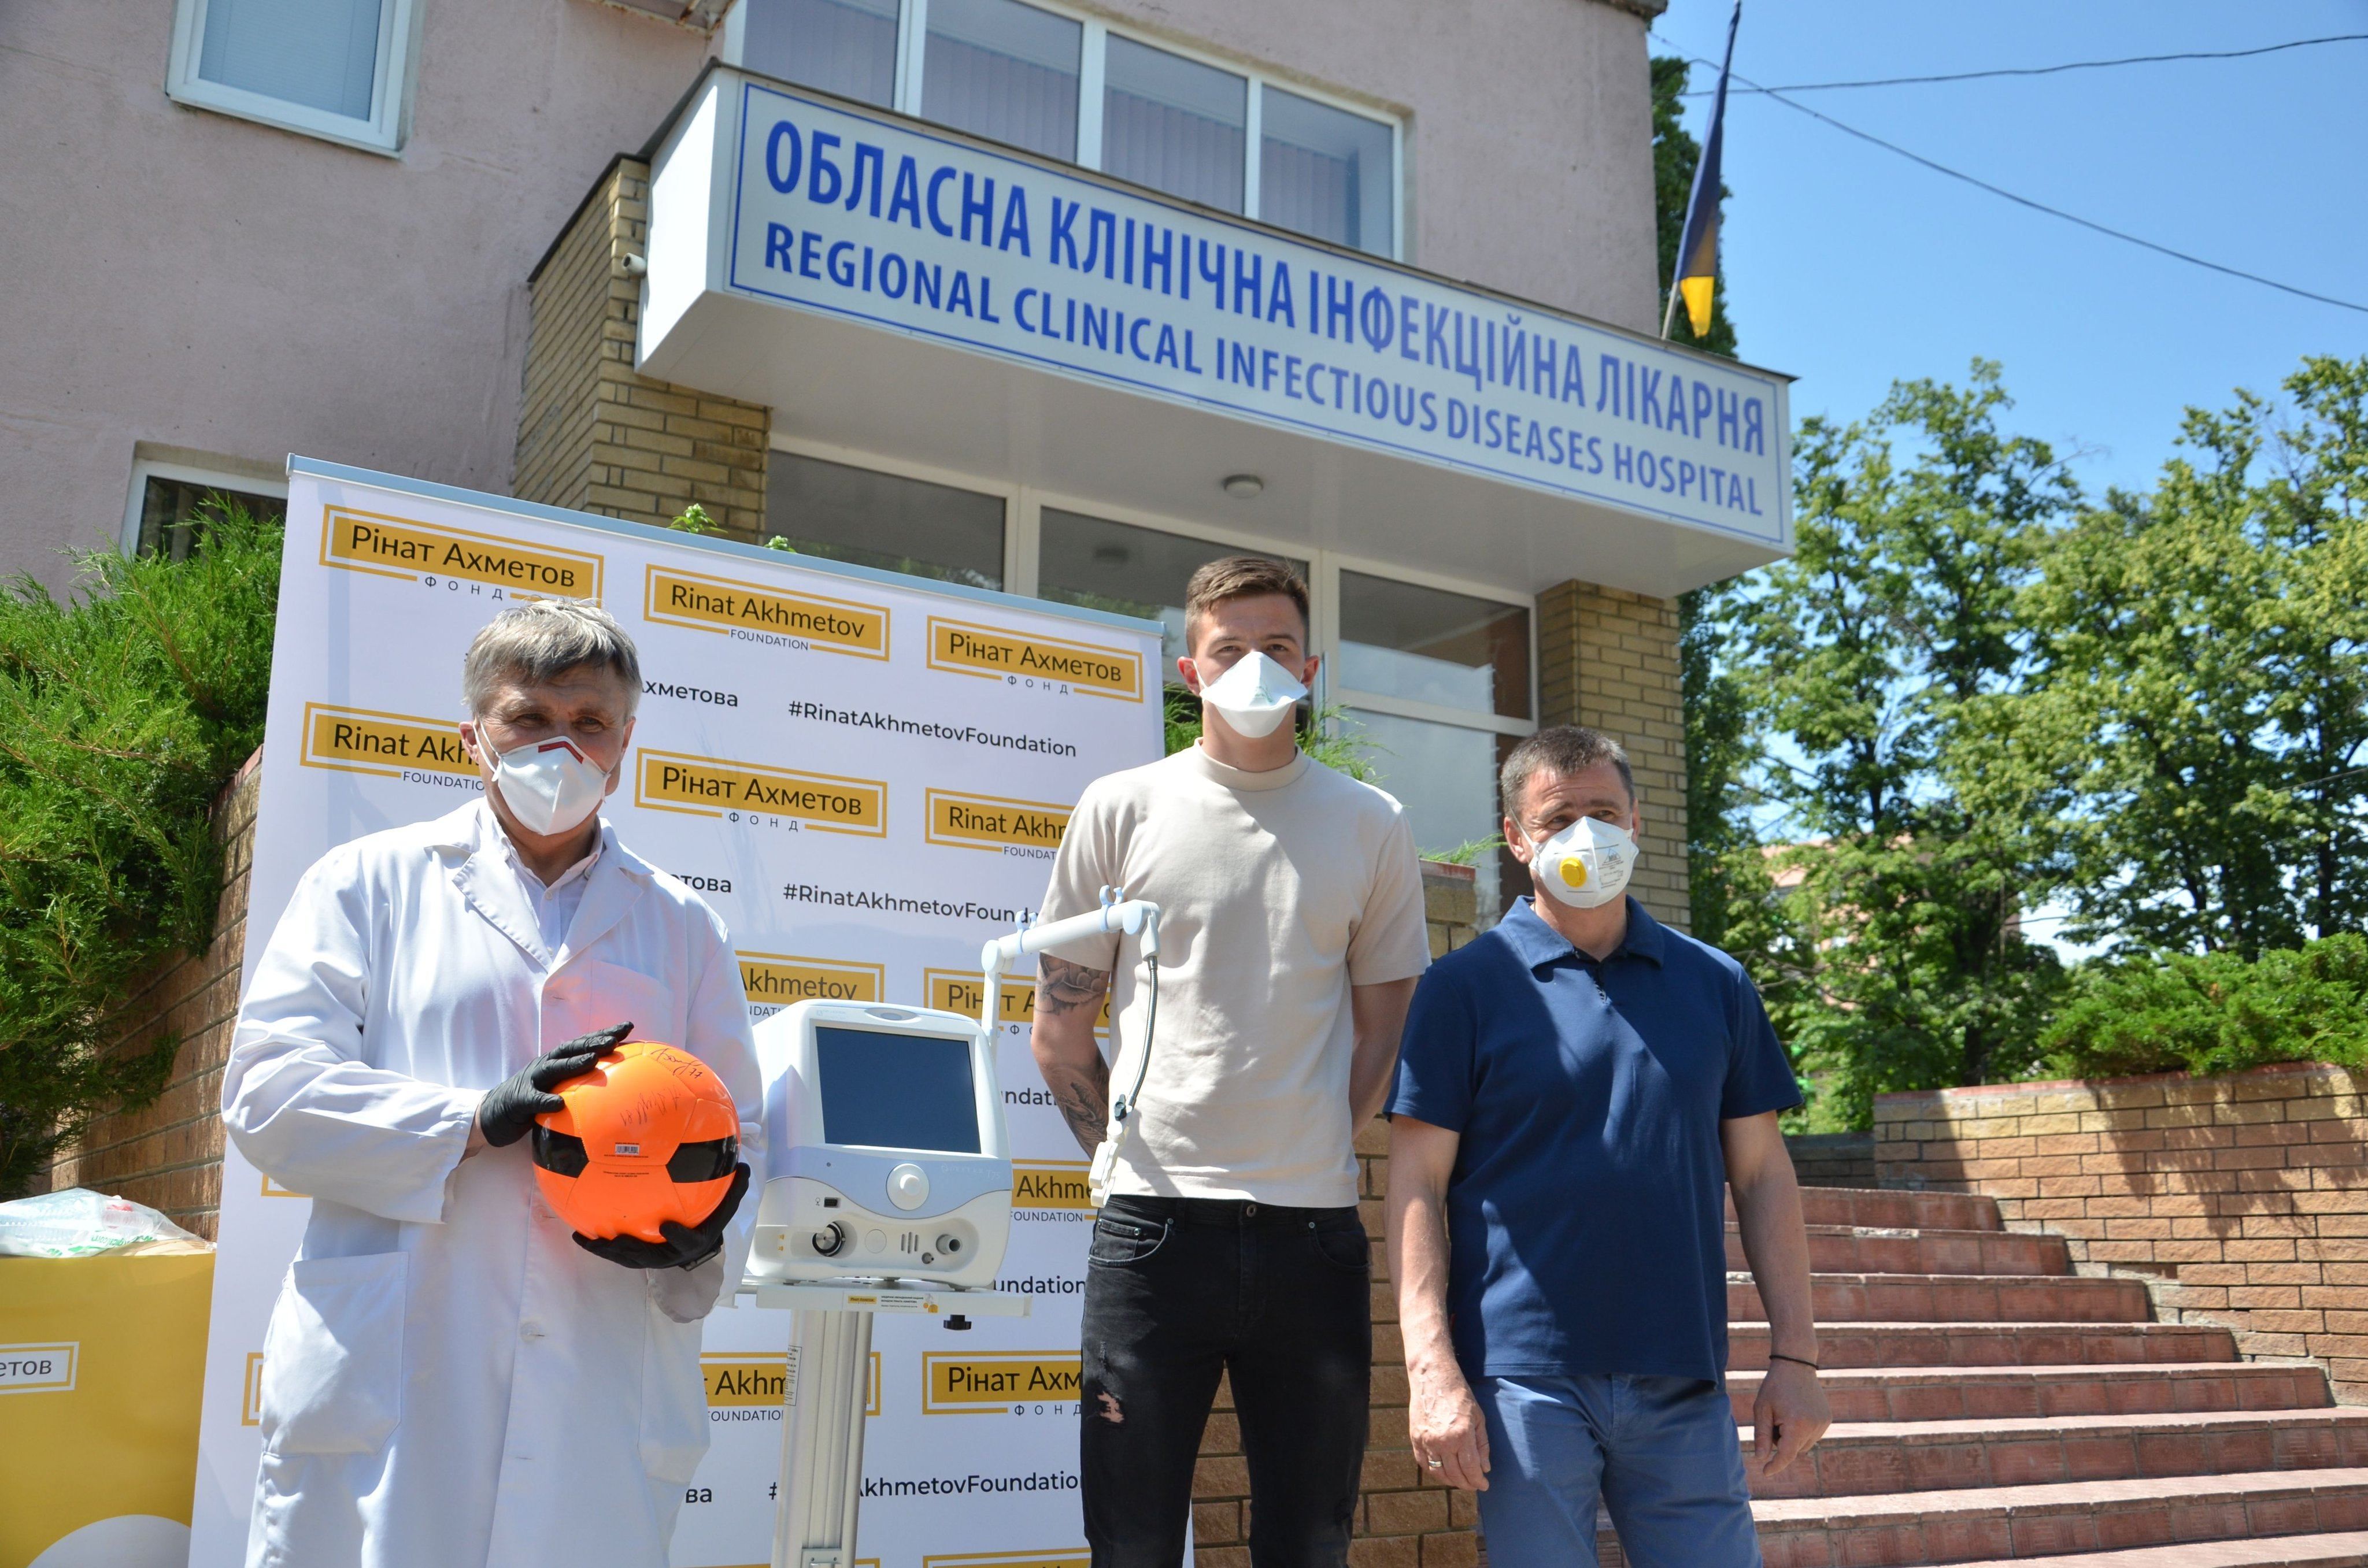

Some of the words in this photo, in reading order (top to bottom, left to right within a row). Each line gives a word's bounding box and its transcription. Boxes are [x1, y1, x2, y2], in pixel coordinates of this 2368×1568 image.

[766, 120, 1031, 257] ОБЛАСНА
[1049, 197, 1295, 328] КЛІНІЧНА
[1309, 270, 1585, 407] ІНФЕКЦІЙНА
[1597, 354, 1764, 456] ЛІКАРНЯ
[765, 222, 1000, 323] REGIONAL
[1013, 287, 1202, 375] CLINICAL
[1216, 338, 1437, 432] INFECTIOUS
[1448, 398, 1603, 475] DISEASES
[1614, 443, 1762, 516] HOSPITAL
[352, 524, 435, 562] Рінат
[443, 542, 574, 587] Ахметов
[671, 584, 734, 616] Rinat
[741, 598, 864, 637] Akhmetov
[731, 629, 809, 651] FOUNDATION
[950, 632, 1013, 663] Рінат
[1020, 646, 1122, 681] Ахметов
[642, 680, 738, 706] хметова
[334, 724, 410, 756] Rinat
[416, 736, 479, 766] Akh
[789, 700, 1076, 757] #RinatAkhmetovFoundation
[663, 766, 736, 798] Рінат
[744, 778, 861, 815] Ахметов
[950, 806, 1007, 833] Rinat
[670, 874, 731, 893] това
[783, 883, 1038, 923] #RinatAkhmetovFound
[1001, 1088, 1057, 1105] ndat
[1011, 1211, 1082, 1222] OUNDATION
[949, 1367, 1020, 1392] Рінат
[708, 1410, 783, 1421] OUNDATIO
